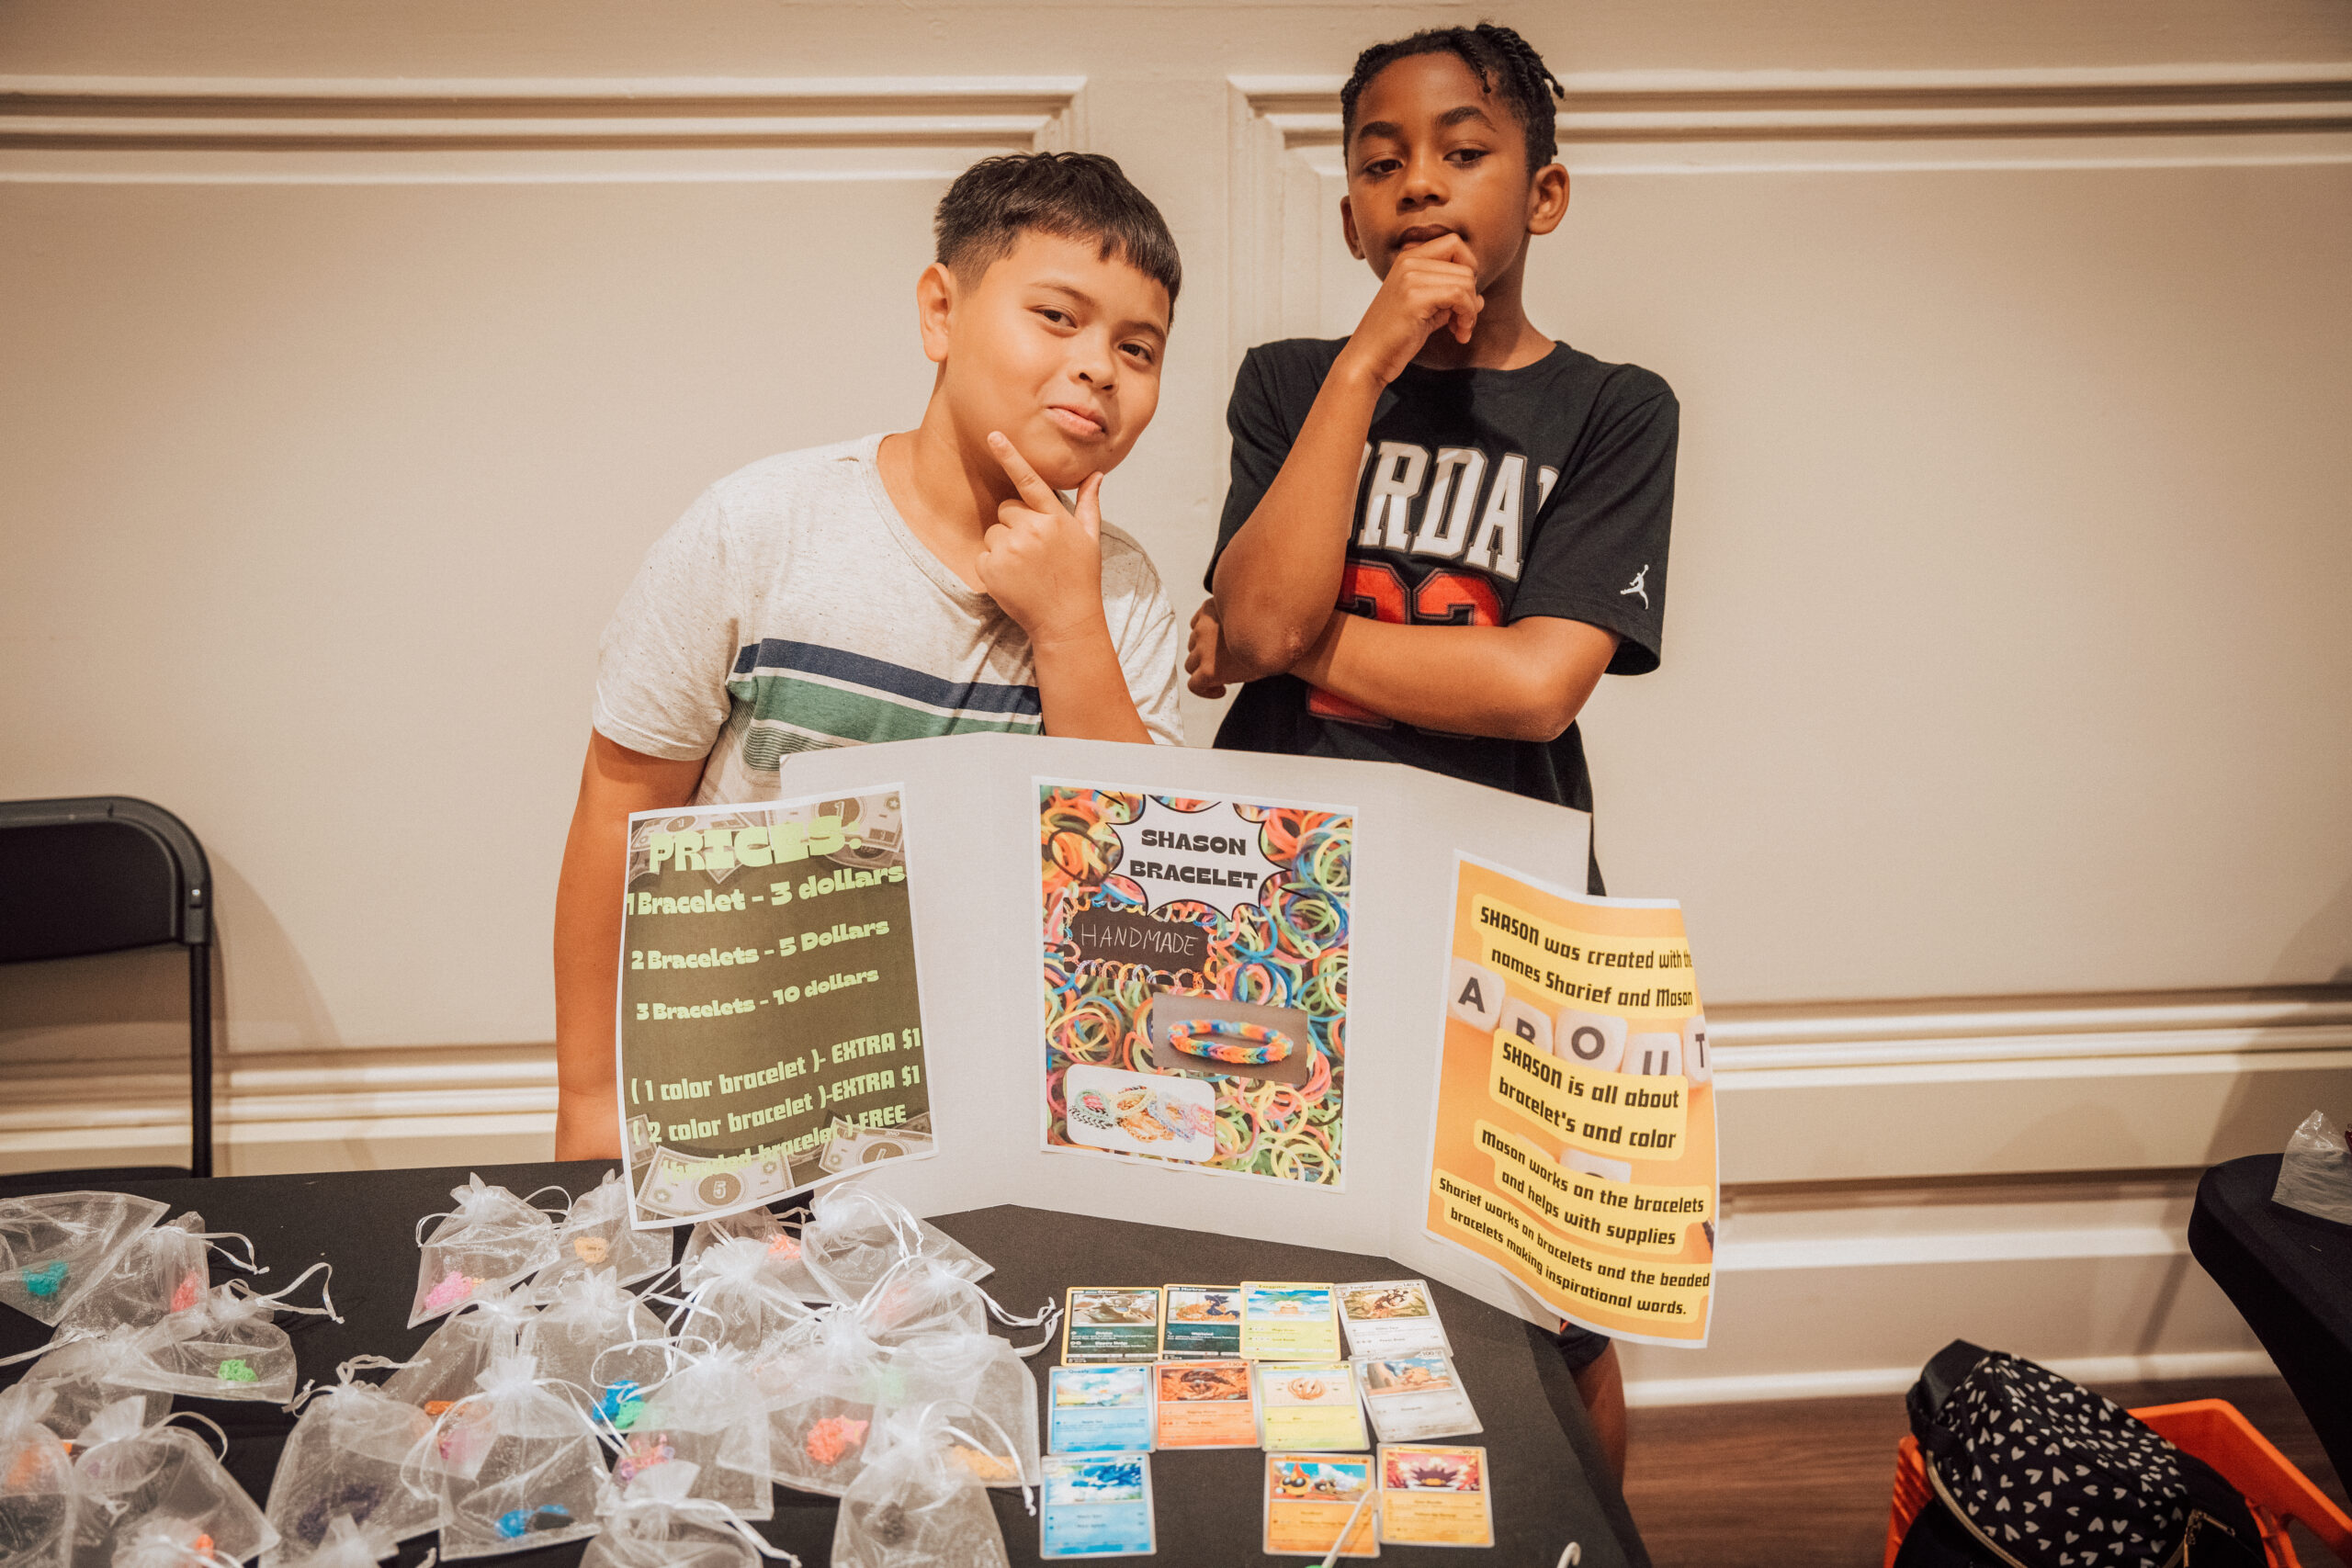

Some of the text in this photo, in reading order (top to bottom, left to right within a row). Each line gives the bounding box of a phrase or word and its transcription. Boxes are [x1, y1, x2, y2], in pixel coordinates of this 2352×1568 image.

[1348, 441, 1559, 582] RDA
[1129, 860, 1258, 889] BRACELET
[1141, 829, 1247, 856] SHASON
[627, 892, 635, 916] 1
[639, 888, 746, 916] Bracelet
[770, 881, 793, 907] 3
[798, 864, 907, 900] dollars
[631, 950, 644, 970] 2
[648, 946, 760, 970] Bracelets
[779, 936, 797, 957] 5
[801, 920, 890, 953] Dollars
[1081, 923, 1199, 956] HANDMADE
[1480, 906, 1539, 945] SHASON
[1544, 937, 1579, 961] was
[1587, 951, 1654, 969] created
[1659, 950, 1682, 969] with
[637, 1003, 650, 1021] 3
[652, 998, 756, 1021] Bracelets
[773, 986, 800, 1006] 10
[804, 969, 879, 998] dollars
[1491, 947, 1693, 1007] names Sharief and Mason
[644, 1080, 654, 1101] 1
[660, 1077, 713, 1100] color
[718, 1056, 807, 1094] bracelet
[831, 1032, 896, 1064] EXTRA
[901, 1028, 921, 1050] $1
[1502, 1042, 1679, 1109] SHASON is all about
[648, 1121, 662, 1143] 2
[668, 1118, 721, 1142] color
[727, 1092, 814, 1133] bracelet
[901, 1065, 921, 1087] $1
[758, 1122, 840, 1164] bracelet
[858, 1104, 907, 1133] FREE
[1498, 1077, 1677, 1148] bracelet's and color
[1482, 1129, 1704, 1213] Mason works on the bracelets
[1439, 1177, 1710, 1287] Sharief works on bracelets and the beaded
[1501, 1170, 1676, 1246] and helps with supplies
[1451, 1207, 1687, 1315] bracelets making inspirational words.
